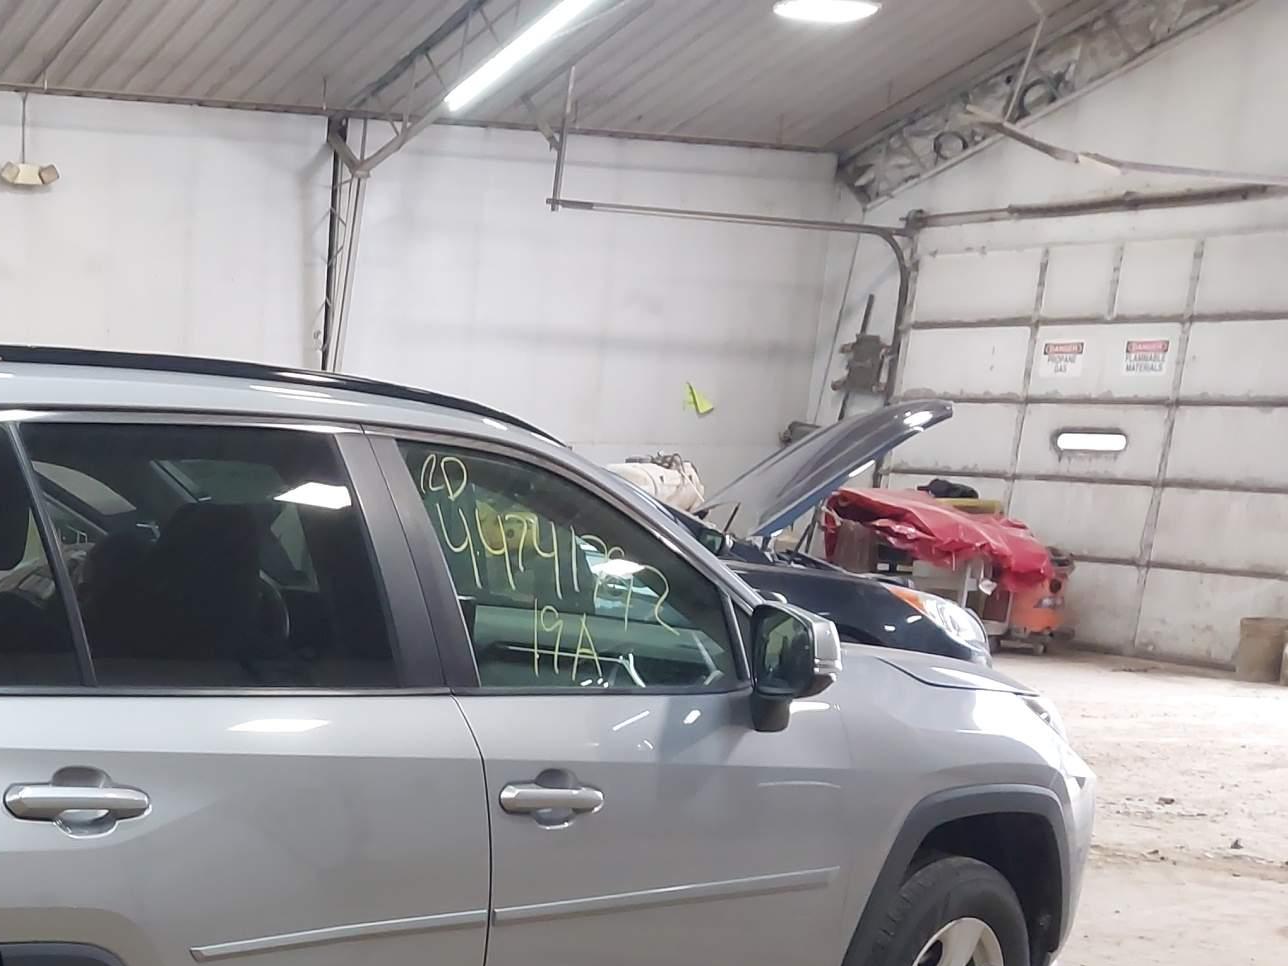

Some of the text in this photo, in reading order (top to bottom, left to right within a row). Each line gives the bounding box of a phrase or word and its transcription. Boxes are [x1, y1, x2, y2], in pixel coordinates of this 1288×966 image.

[1125, 352, 1165, 361] FLAMMABLE
[1053, 362, 1067, 373] GAS
[1125, 361, 1163, 371] MATERIALS
